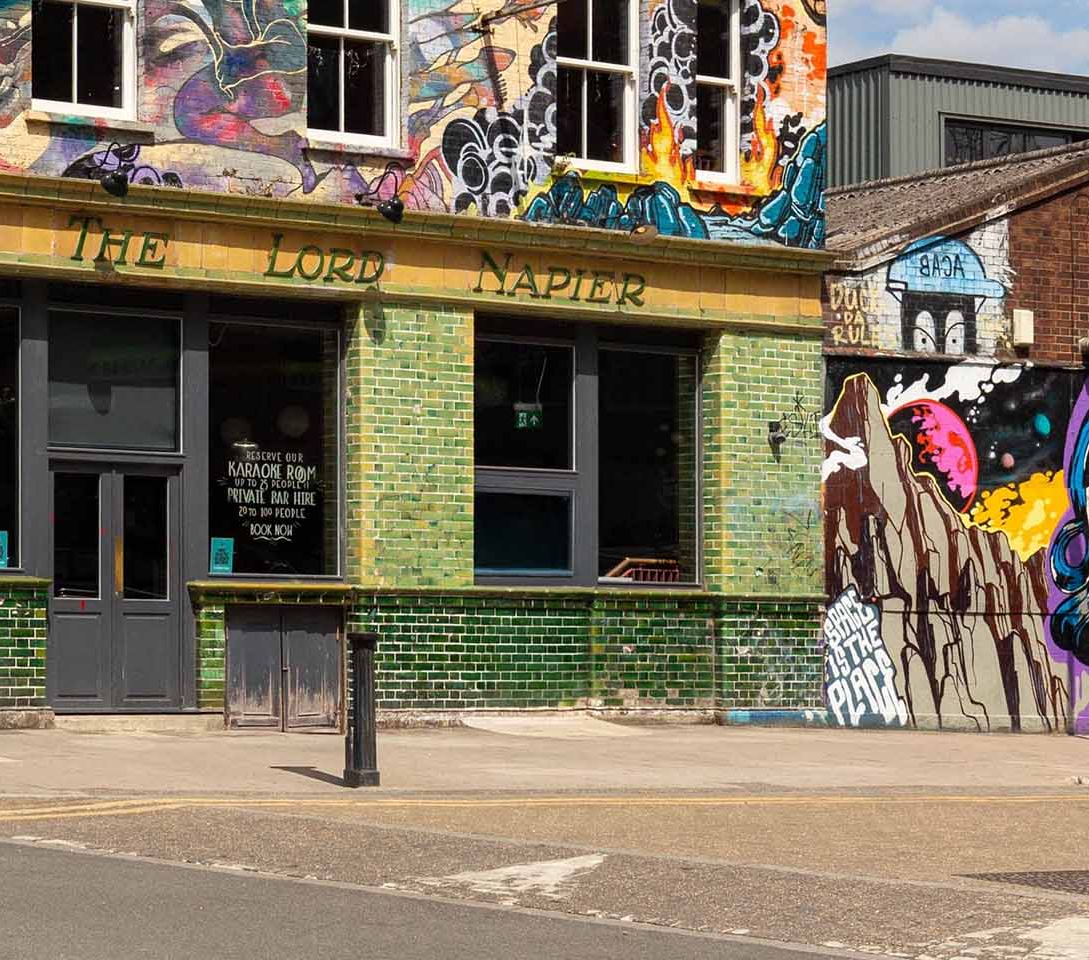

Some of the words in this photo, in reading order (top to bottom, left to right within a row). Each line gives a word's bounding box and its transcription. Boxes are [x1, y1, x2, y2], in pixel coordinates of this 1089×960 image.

[69, 215, 169, 269] THE
[263, 232, 385, 284] LORD
[472, 250, 647, 307] NAPIER
[246, 450, 282, 462] RESERVE
[285, 452, 304, 463] OUR
[228, 461, 283, 480] KARAOKE
[286, 464, 316, 483] ROOM
[234, 478, 245, 487] UP
[247, 478, 258, 488] TO
[227, 487, 265, 504] PRIVATE
[271, 490, 290, 505] BAR
[293, 491, 317, 506] HIRE
[248, 507, 257, 517] TO
[260, 507, 273, 518] 100
[275, 507, 306, 519] PEOPLE
[250, 523, 272, 536] BOOK
[274, 523, 293, 536] NOW
[823, 590, 874, 650] SPACE
[828, 646, 852, 679] IS
[843, 619, 883, 667] THE
[827, 647, 908, 727] PLACE
